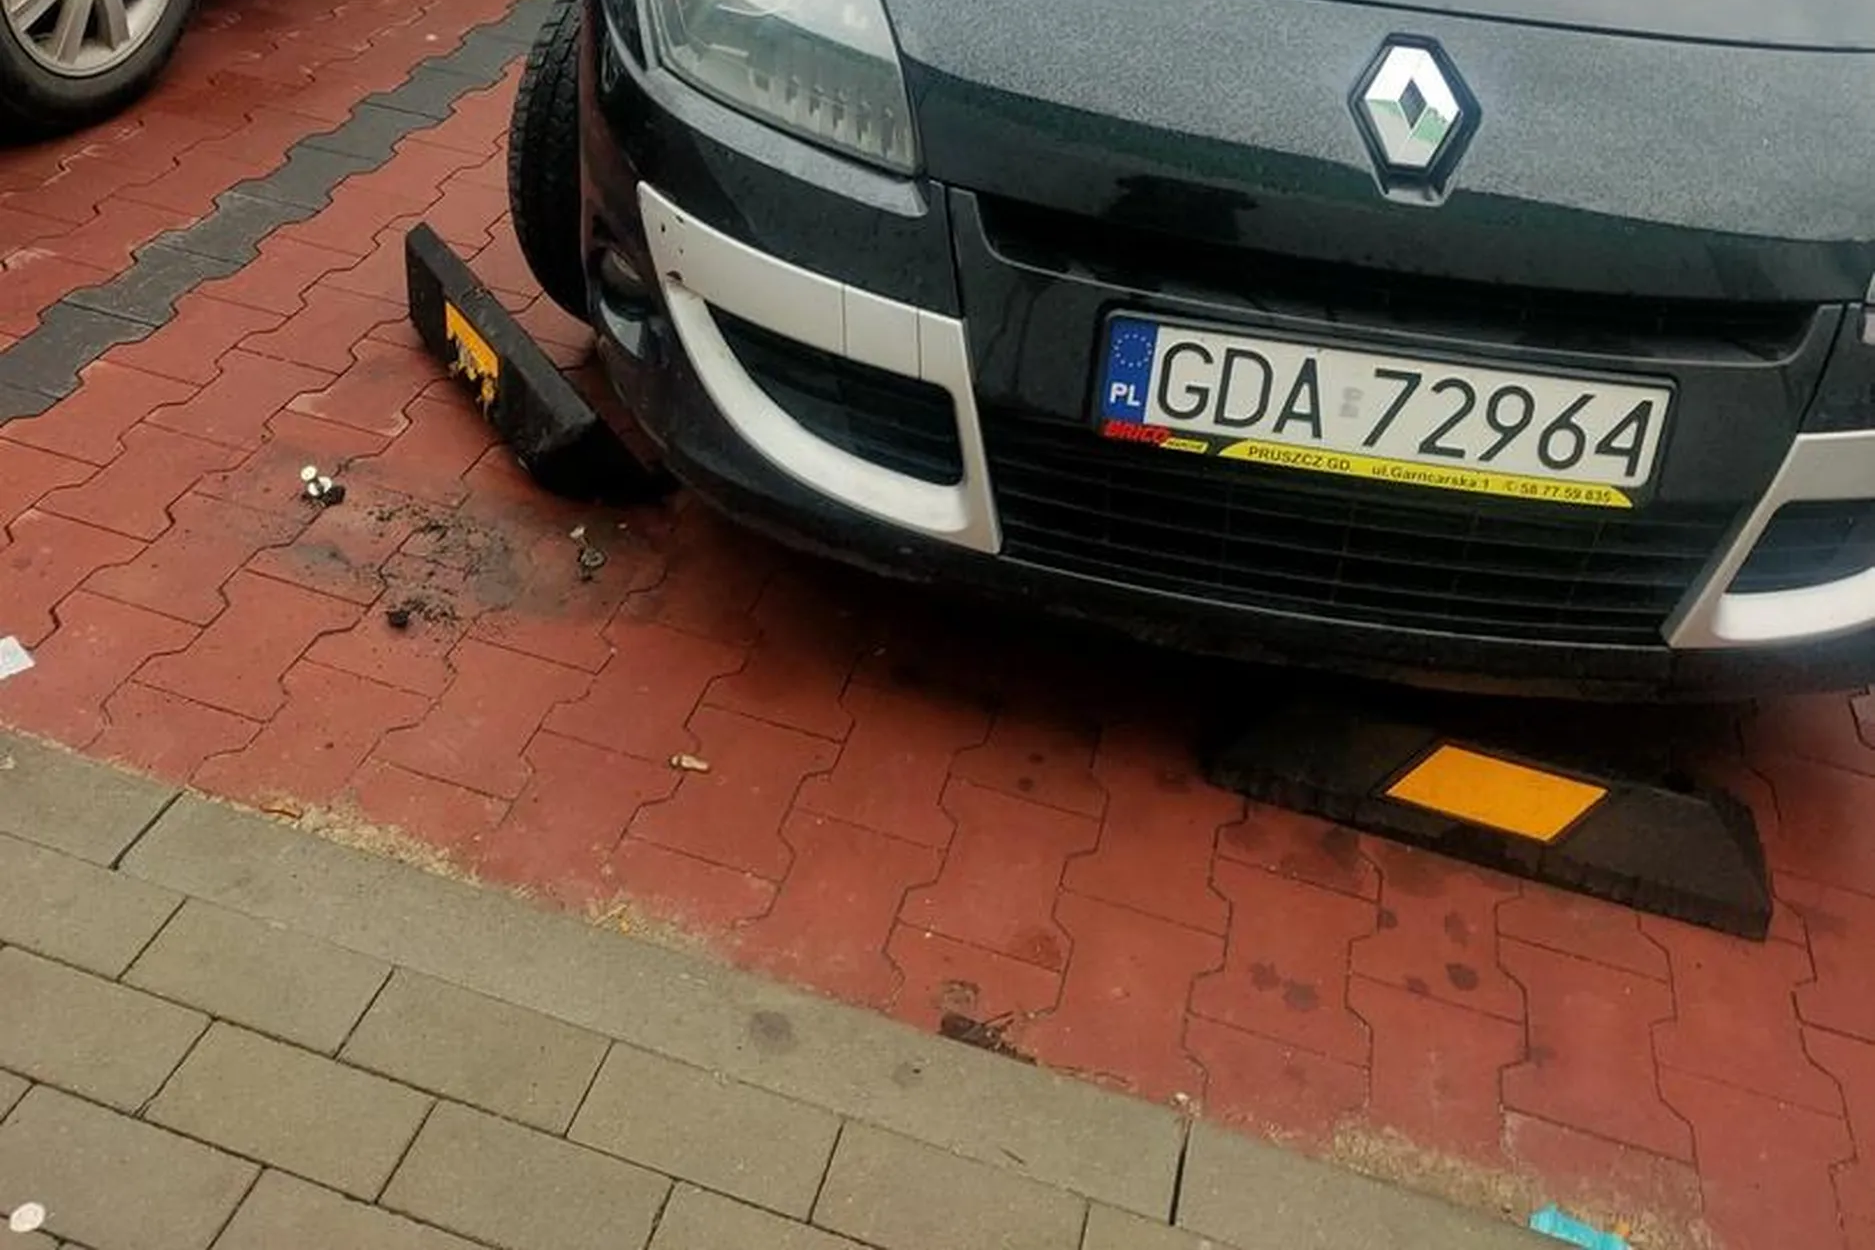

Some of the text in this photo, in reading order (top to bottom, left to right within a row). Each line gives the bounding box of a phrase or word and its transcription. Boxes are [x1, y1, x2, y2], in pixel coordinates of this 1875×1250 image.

[1110, 382, 1142, 406] PL
[1157, 341, 1653, 478] GDA 72964
[1248, 445, 1323, 468] PRUSZCZ
